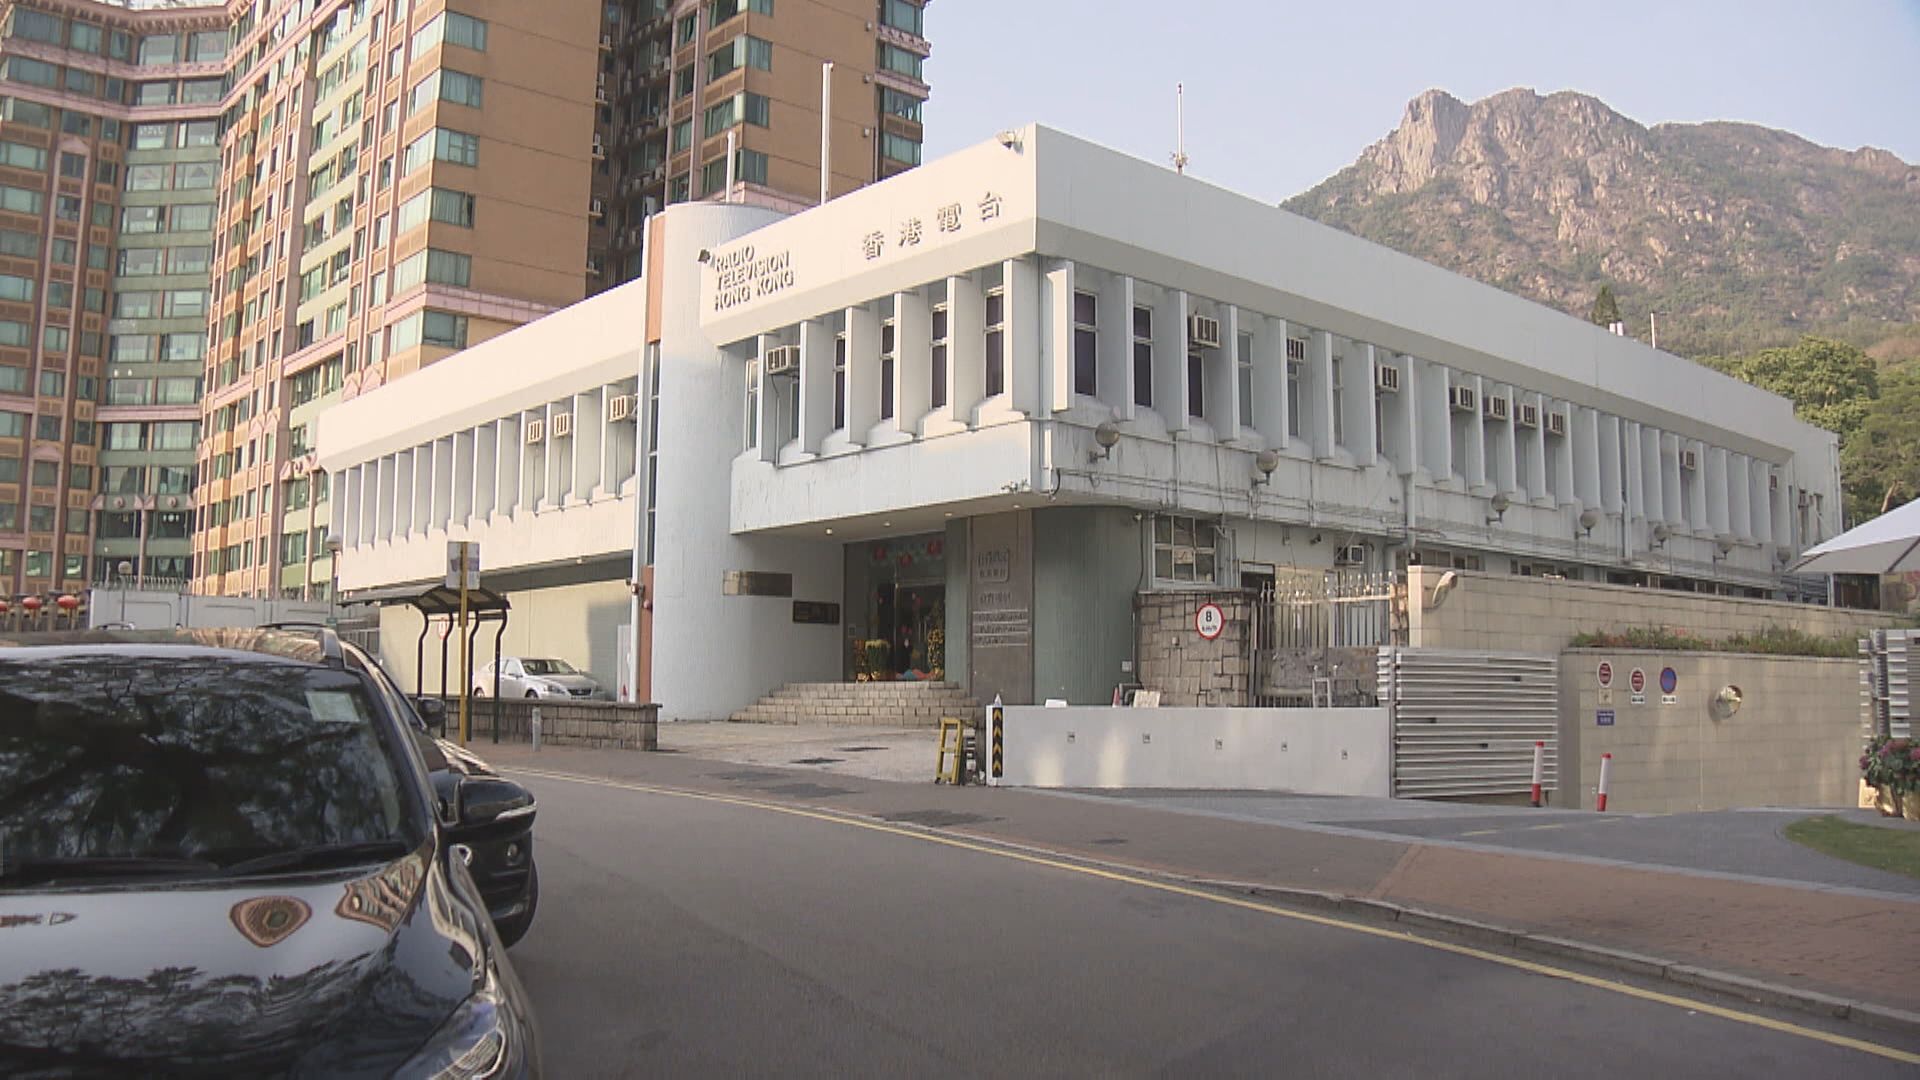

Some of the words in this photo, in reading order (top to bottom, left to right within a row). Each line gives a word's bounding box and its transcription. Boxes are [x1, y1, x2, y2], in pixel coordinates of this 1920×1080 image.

[862, 191, 1002, 260] 香港電台
[716, 245, 755, 273] RADIO
[718, 248, 790, 291] TELEVISION
[715, 286, 751, 311] HONG
[757, 270, 794, 297] KONG
[1205, 610, 1213, 622] 8
